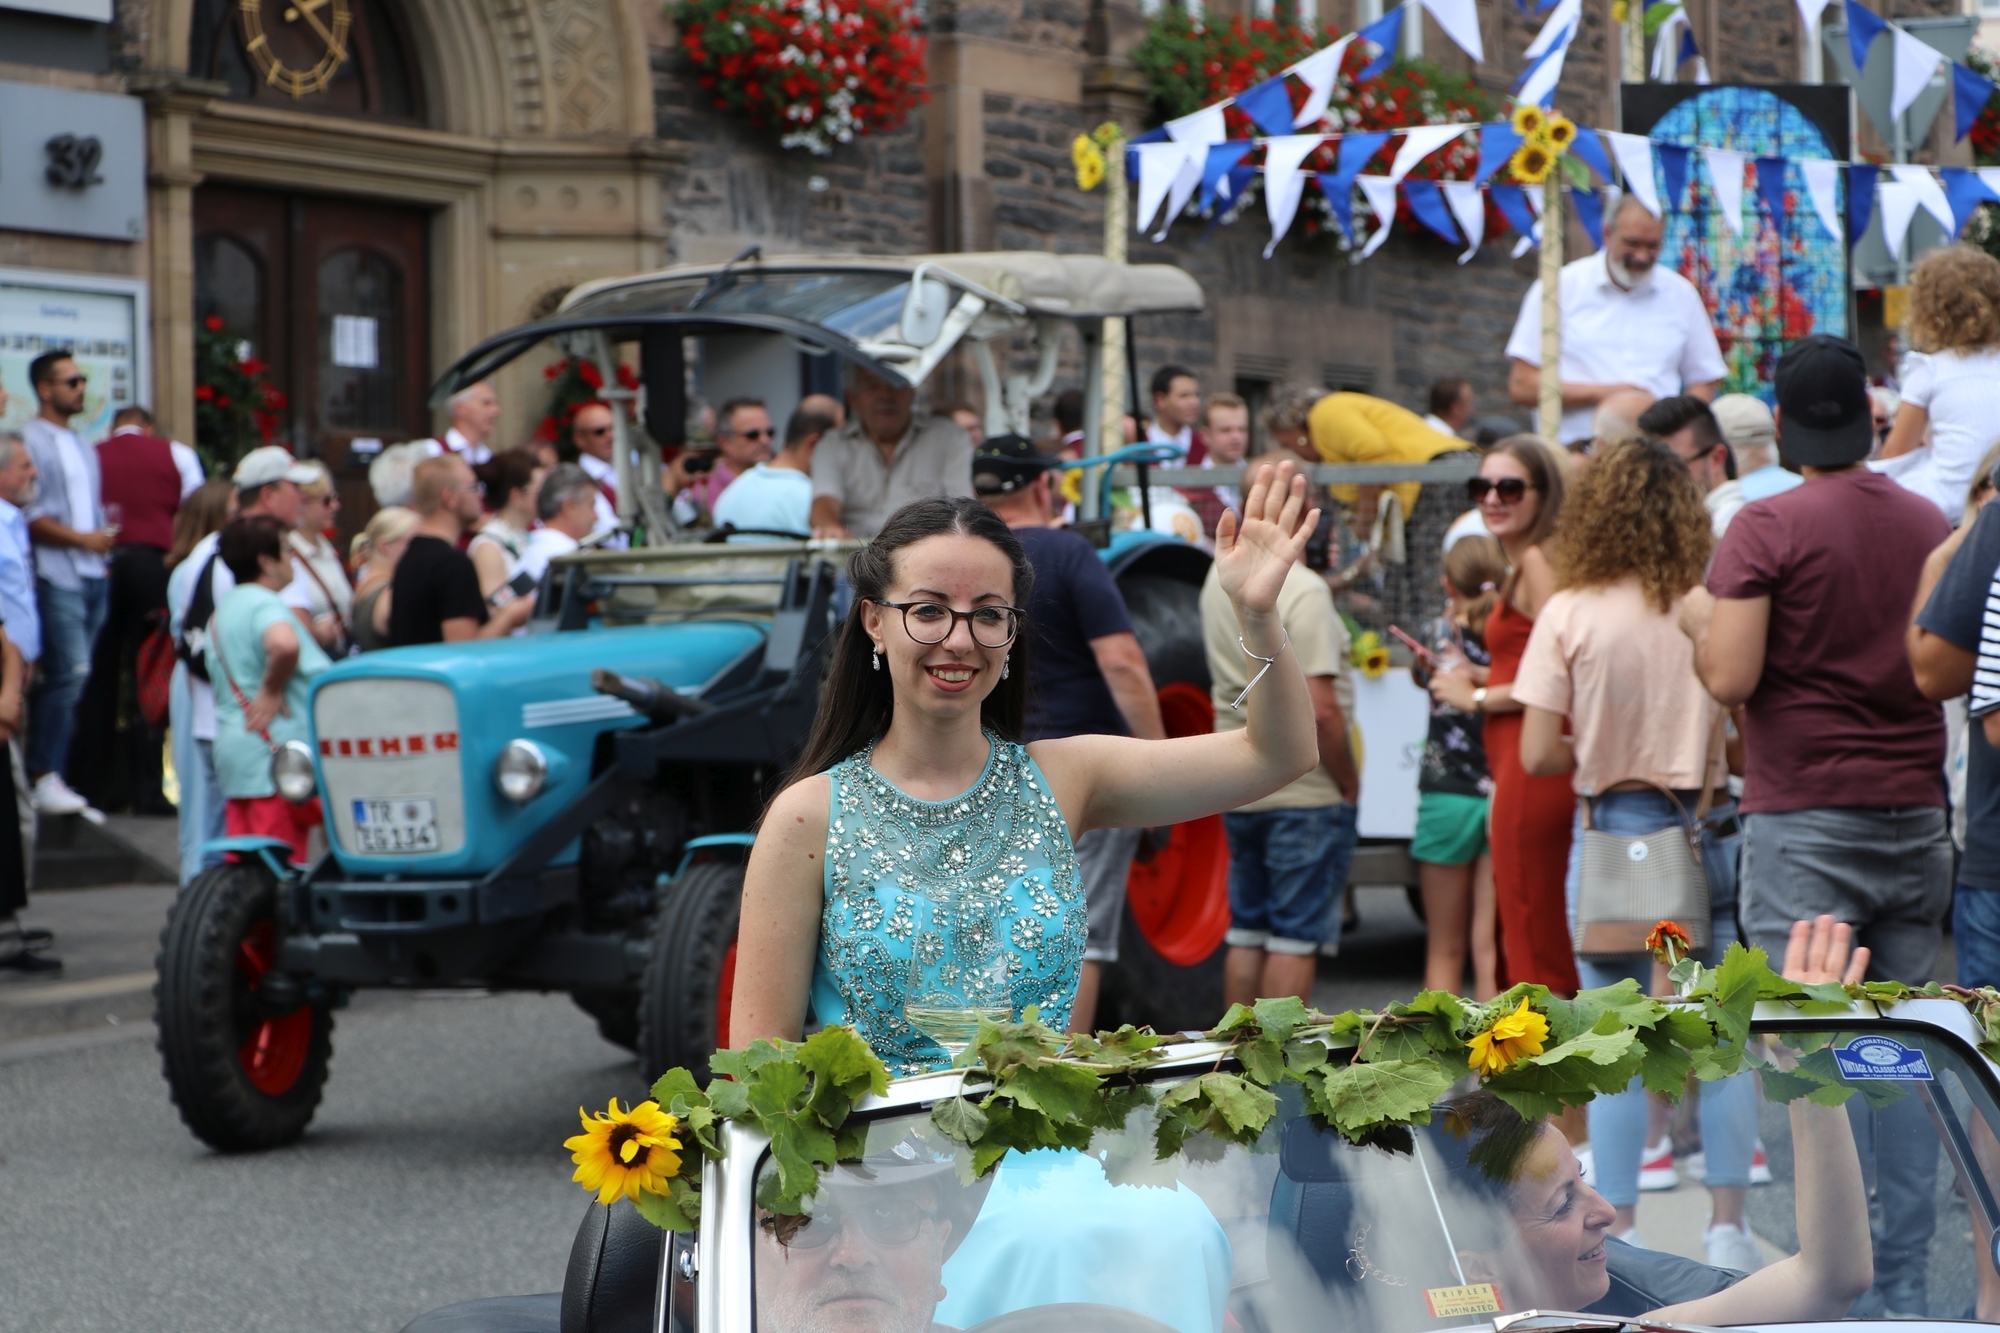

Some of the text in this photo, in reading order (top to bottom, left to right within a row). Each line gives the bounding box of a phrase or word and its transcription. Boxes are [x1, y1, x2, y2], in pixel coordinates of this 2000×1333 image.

[46, 132, 103, 187] 32
[320, 731, 457, 757] EICHER
[366, 801, 392, 824] TR
[1850, 1038, 1903, 1053] INTERNATIONAL
[1839, 1057, 1928, 1074] VINTAGE & CLASSIC CAR TOURS
[1433, 1287, 1488, 1299] TRIPLEX
[1439, 1304, 1494, 1316] LAMINATED
